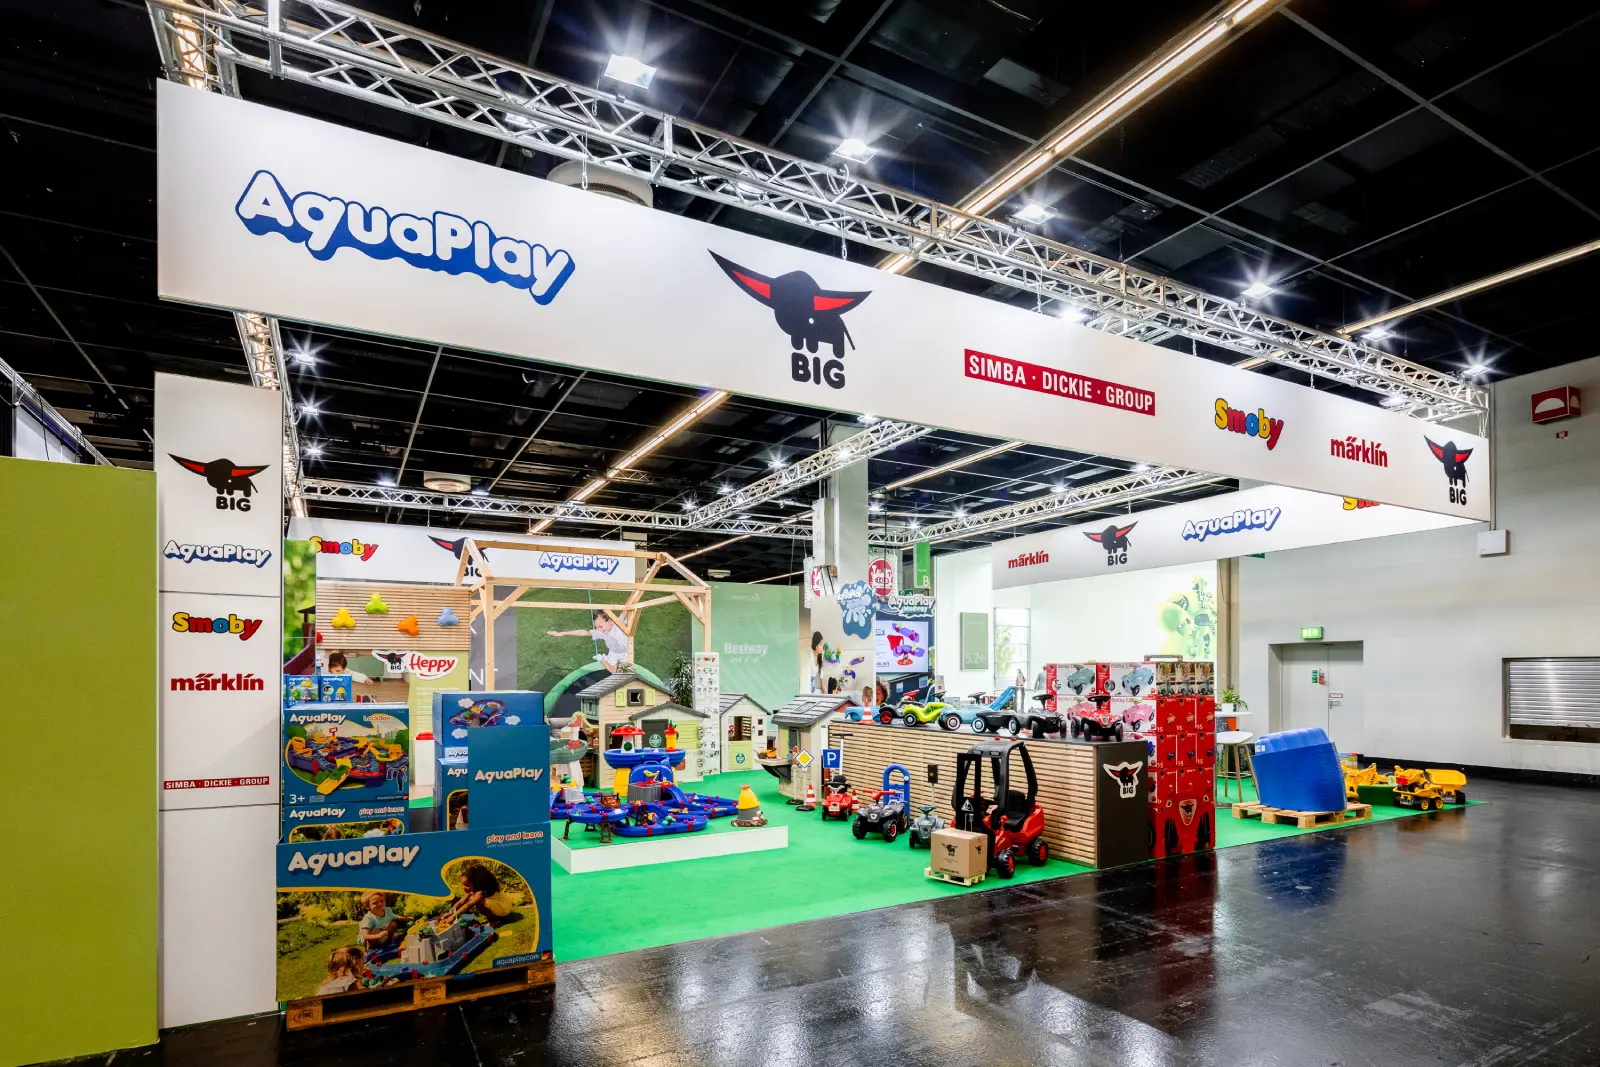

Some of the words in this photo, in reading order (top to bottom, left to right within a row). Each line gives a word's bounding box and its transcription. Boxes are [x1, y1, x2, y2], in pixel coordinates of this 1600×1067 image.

[235, 169, 576, 305] AquaPlay
[790, 350, 846, 389] BIG
[968, 353, 1026, 386] SIMBA
[1041, 370, 1093, 401] DICKIE
[1104, 383, 1154, 413] GROUP
[1214, 398, 1284, 451] Smoby
[215, 495, 252, 512] BIG
[1448, 485, 1468, 507] BIG
[1181, 506, 1281, 543] AquaPlay
[163, 539, 273, 568] AquaPlay
[310, 535, 379, 562] Smoby
[538, 551, 620, 575] AquaPlay
[1107, 551, 1128, 567] BIG
[889, 595, 936, 611] AquaPlay
[172, 611, 263, 642] Smoby
[723, 643, 769, 657] Bestway
[409, 653, 456, 673] Heppy
[289, 713, 346, 725] AquaPlay
[447, 749, 468, 758] Aqua
[827, 751, 837, 766] P
[165, 780, 197, 790] SIMBA
[203, 778, 233, 788] DICKIE
[239, 776, 269, 787] GROUP
[474, 767, 544, 785] AquaPlay
[1122, 786, 1134, 794] BIG
[289, 794, 306, 805] 3+
[289, 807, 346, 821] AquaPlay
[486, 834, 505, 845] play
[505, 831, 521, 841] and
[523, 830, 544, 840] learn
[288, 844, 420, 876] AquaPlay
[496, 953, 540, 966] aquaplay.com
